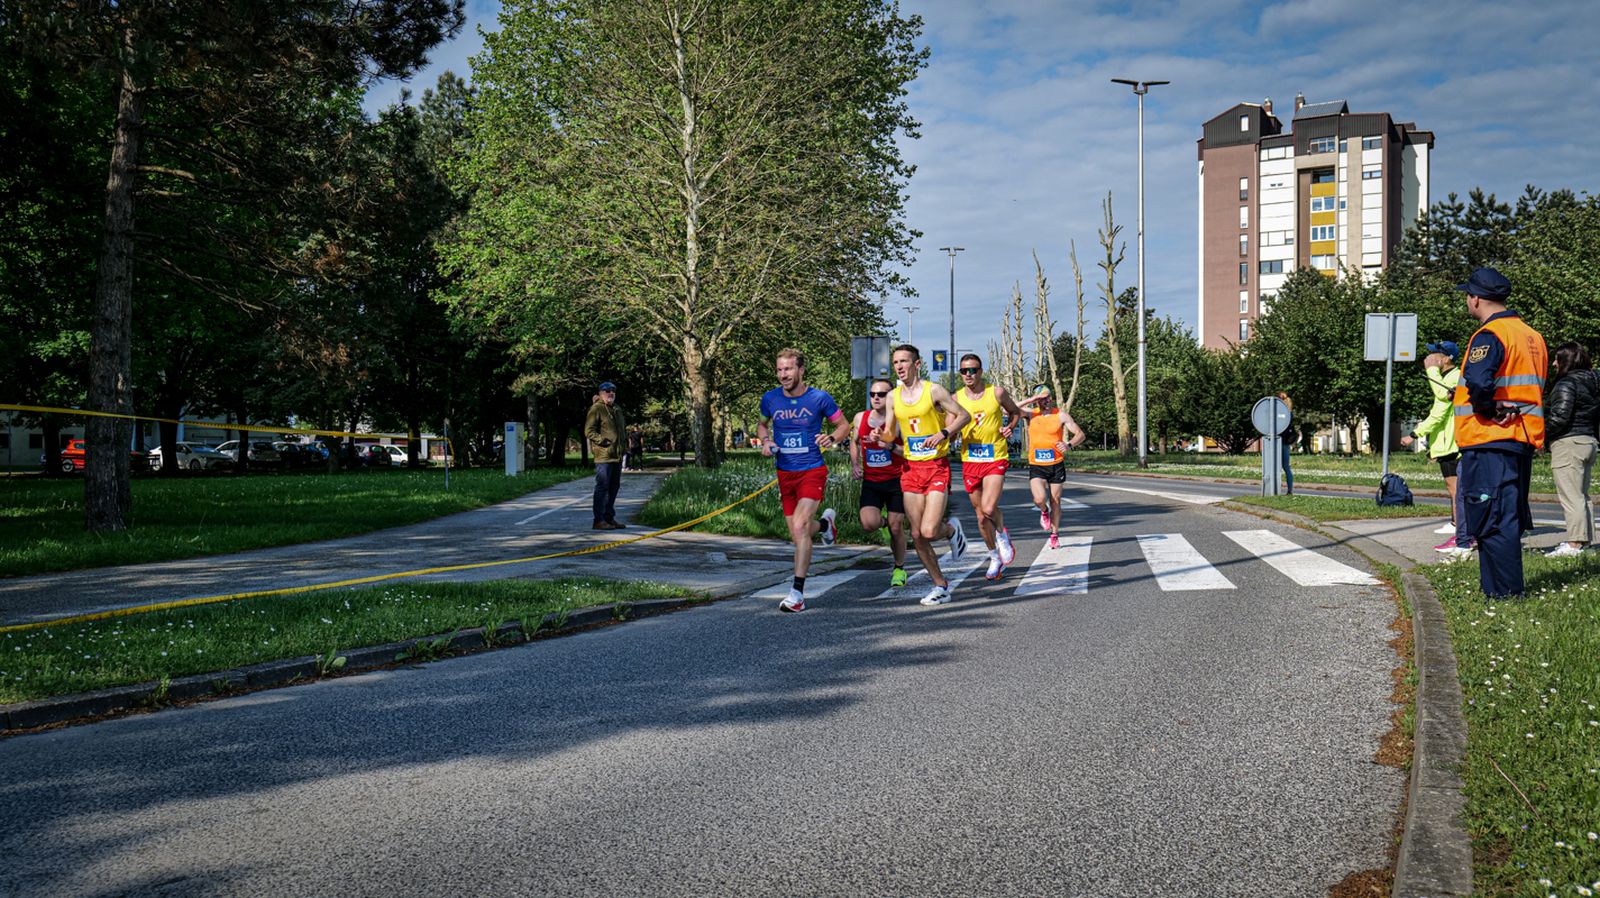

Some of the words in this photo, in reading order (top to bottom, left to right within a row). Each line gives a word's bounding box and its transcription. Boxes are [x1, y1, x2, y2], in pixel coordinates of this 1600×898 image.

[783, 437, 803, 448] 481
[972, 448, 990, 457] 404
[869, 453, 887, 462] 426
